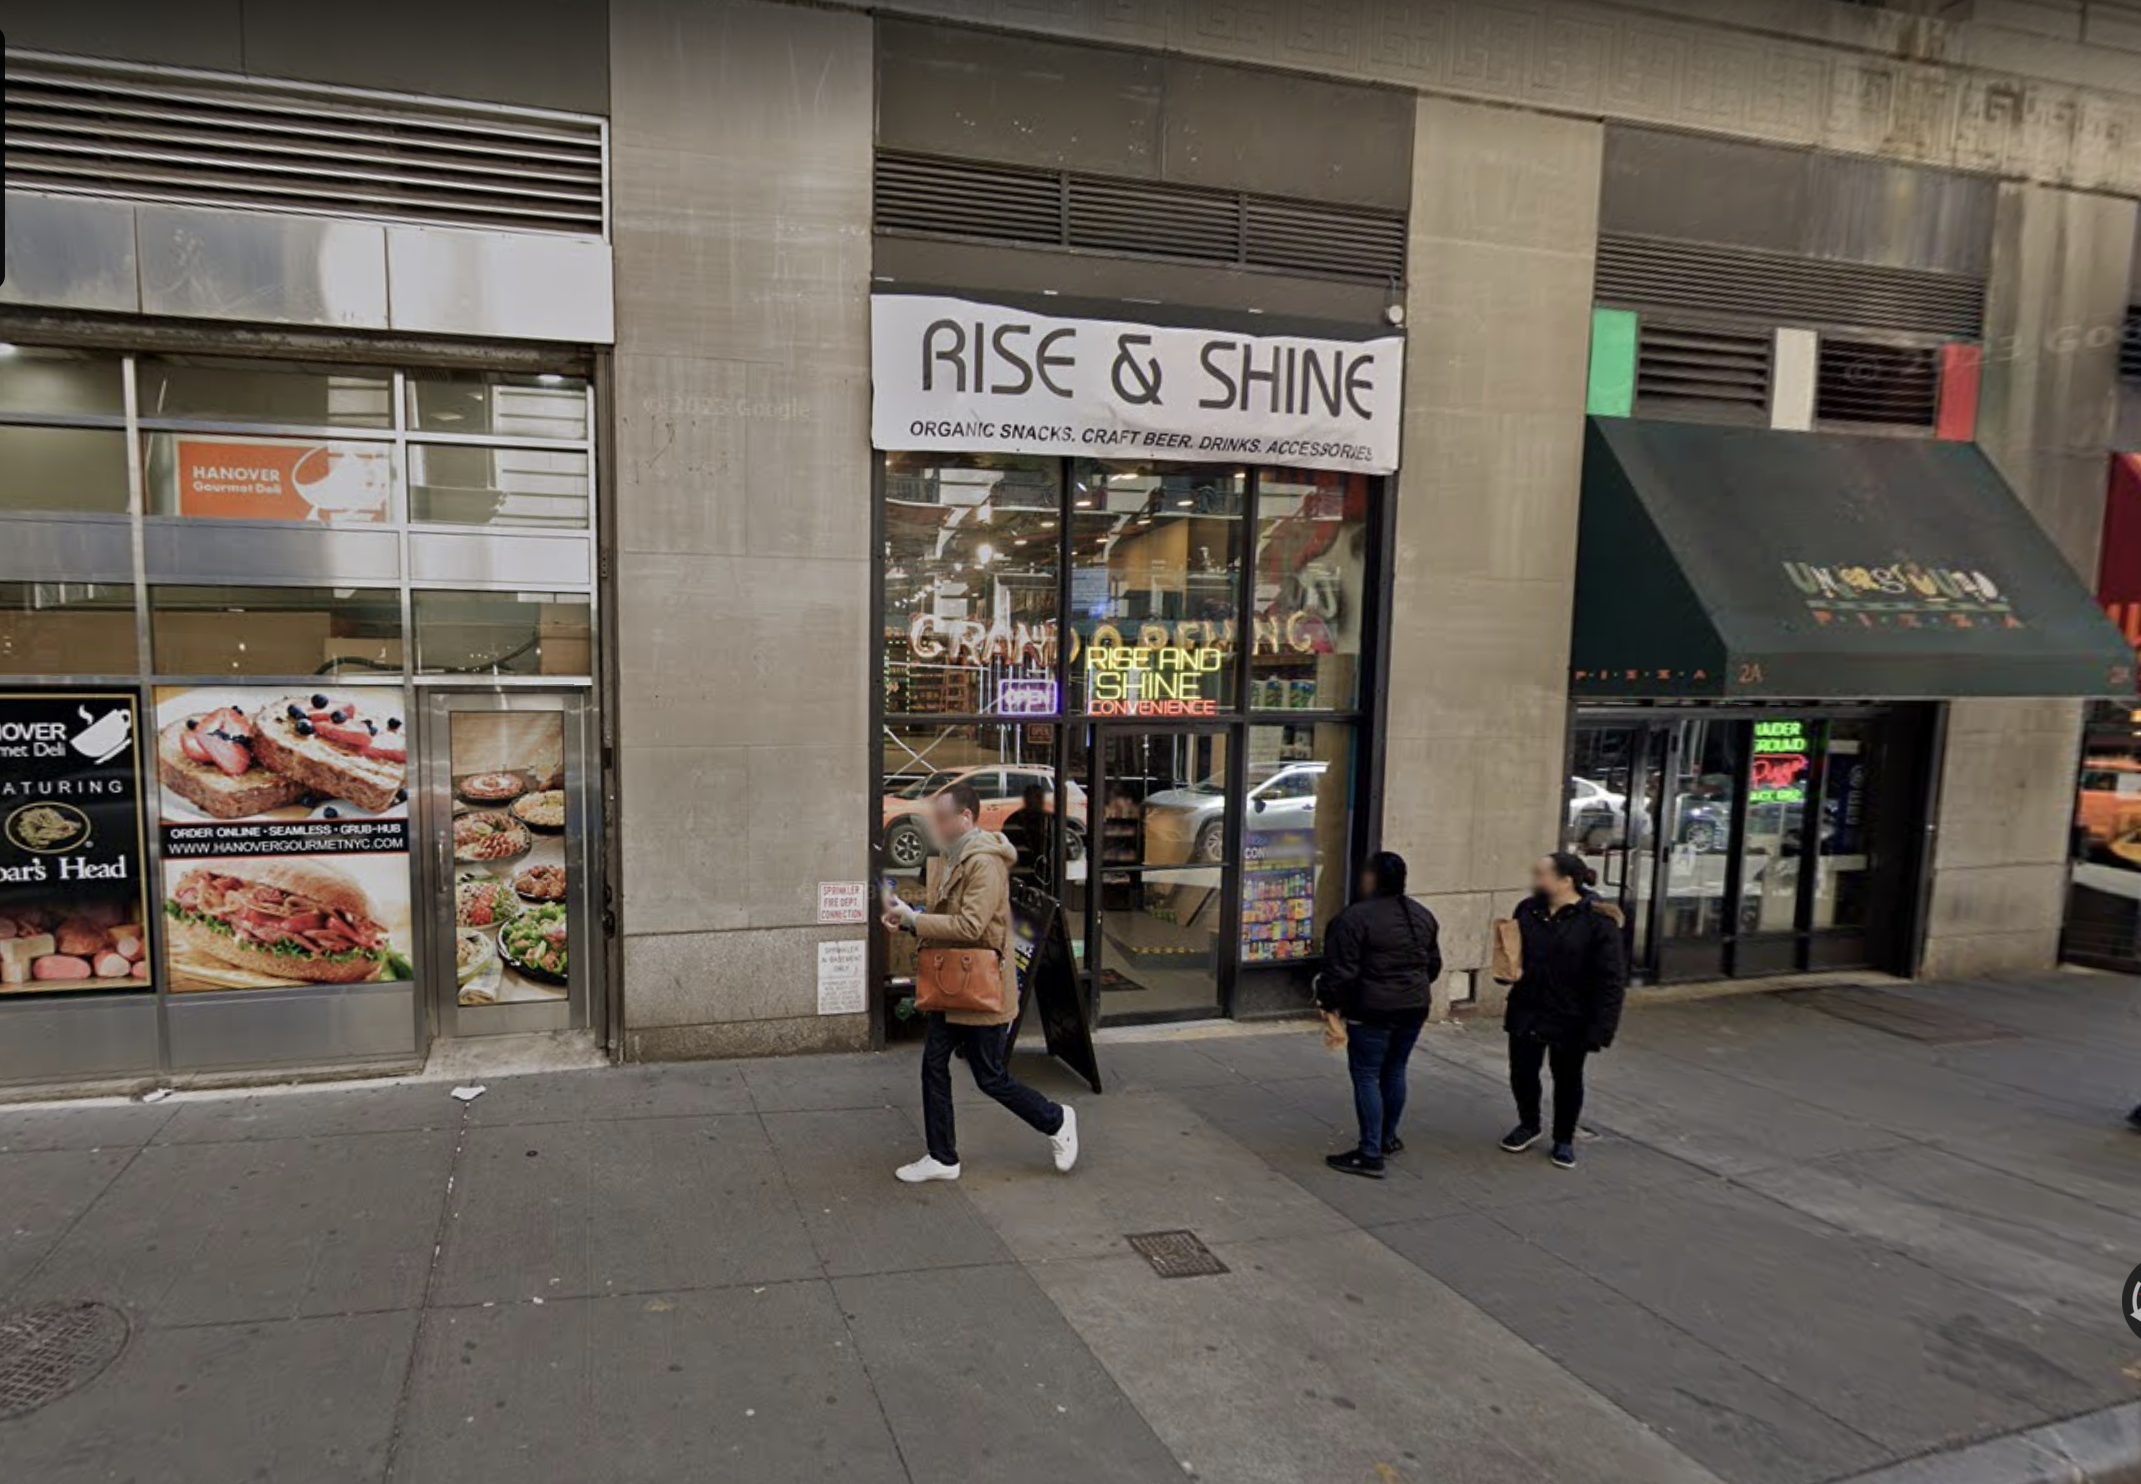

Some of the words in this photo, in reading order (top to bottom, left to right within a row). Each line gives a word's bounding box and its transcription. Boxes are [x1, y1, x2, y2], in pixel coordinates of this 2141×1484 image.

[922, 318, 1077, 398] RISE
[1110, 334, 1164, 406] &
[1200, 340, 1374, 420] SHINE
[910, 420, 996, 437] ORGANIC
[1081, 428, 1141, 445] CRAFT
[1266, 440, 1373, 462] ACCESSORIES
[192, 465, 280, 482] HANOVER
[193, 480, 253, 494] Gourmet
[255, 482, 282, 495] Deli
[1091, 610, 1312, 668] OPENNG
[1086, 646, 1150, 671] RISE
[1159, 646, 1221, 672] AND
[1739, 663, 1763, 683] 2A
[1096, 671, 1202, 700] SHINE
[1004, 689, 1050, 705] OPEN
[1089, 699, 1217, 715] CONVENIENCE
[0, 722, 67, 741] OVER
[33, 741, 67, 758] Deli
[3, 779, 124, 796] ATURING
[170, 826, 215, 839] ORDER
[216, 825, 261, 838] ONLINE
[268, 824, 332, 837] SEAMLESS
[340, 823, 401, 835] GRUB-HUB
[168, 837, 404, 854] WWW.HANOVERGOURMETNYC.COM
[58, 854, 128, 881] Head
[823, 885, 860, 896] SPRINKLER
[823, 897, 839, 908] FIRE
[821, 909, 864, 920] CONNECTION
